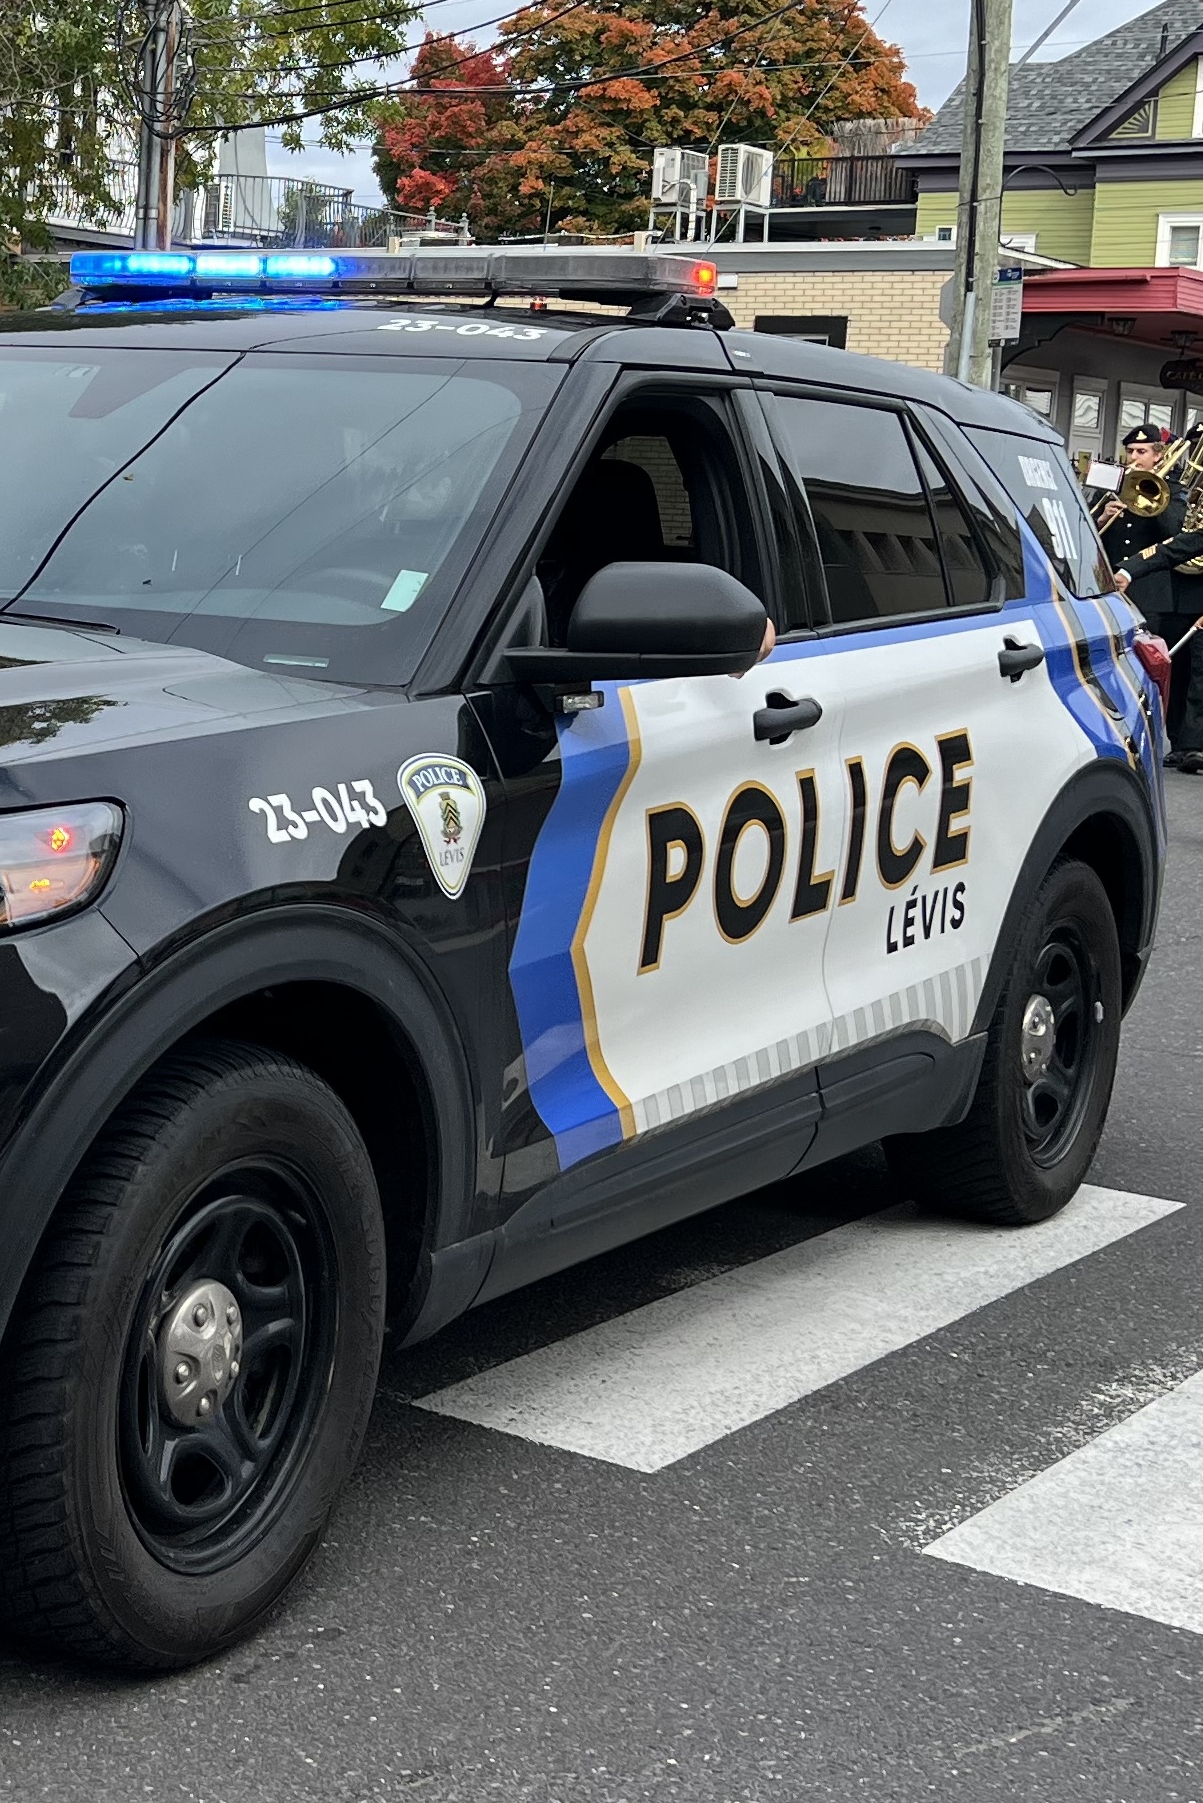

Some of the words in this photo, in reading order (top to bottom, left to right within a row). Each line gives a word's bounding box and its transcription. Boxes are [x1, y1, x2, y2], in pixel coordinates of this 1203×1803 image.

[377, 318, 548, 341] 23-043
[1041, 497, 1078, 560] 911
[248, 778, 388, 844] 23-043
[412, 765, 463, 793] POLICE
[636, 727, 975, 977] POLICE
[886, 881, 966, 955] LÉVIS
